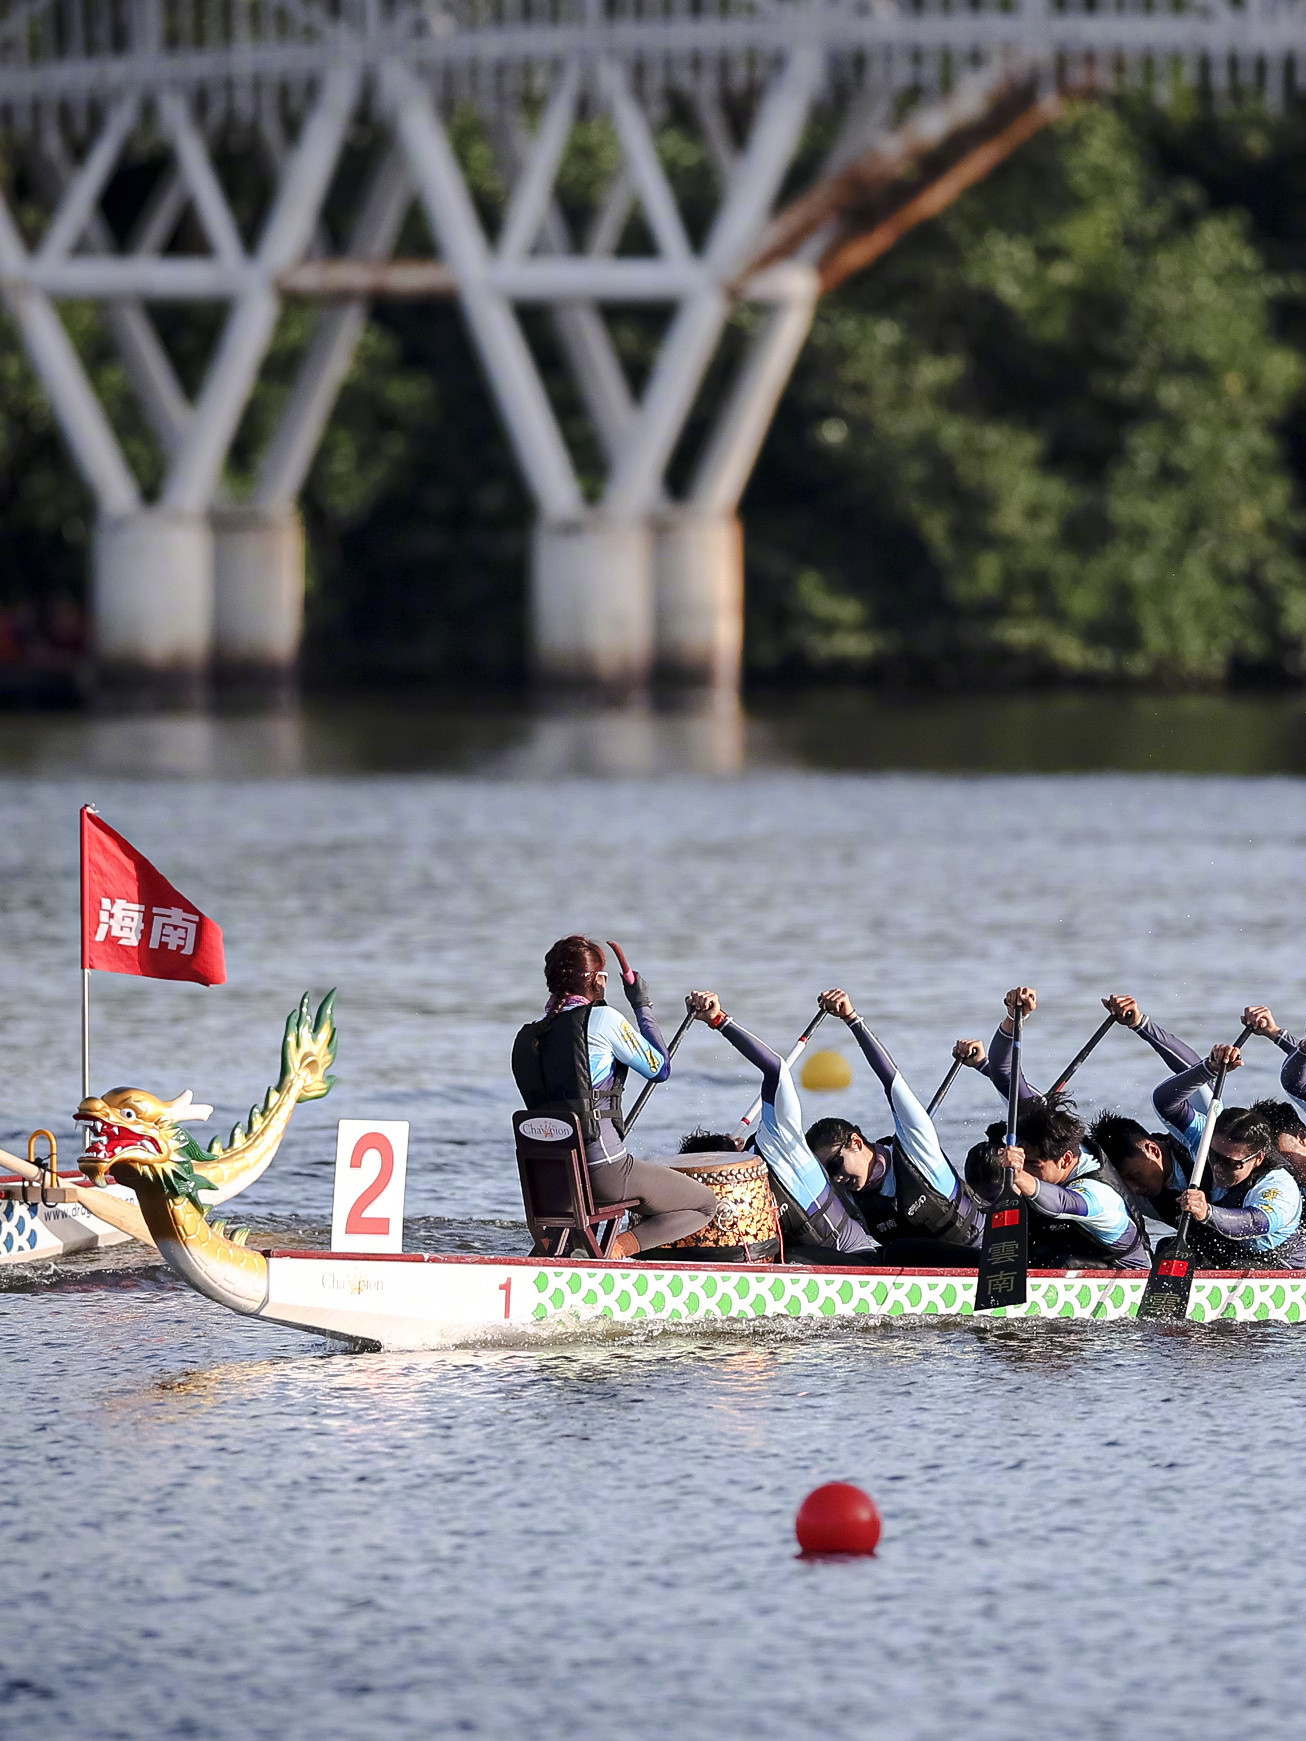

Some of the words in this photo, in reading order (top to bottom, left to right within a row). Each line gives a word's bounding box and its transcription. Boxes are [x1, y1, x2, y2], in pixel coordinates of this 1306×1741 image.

[95, 897, 200, 955] 海南
[345, 1132, 394, 1235] 2
[987, 1240, 1019, 1295] 雲南
[498, 1276, 512, 1319] 1
